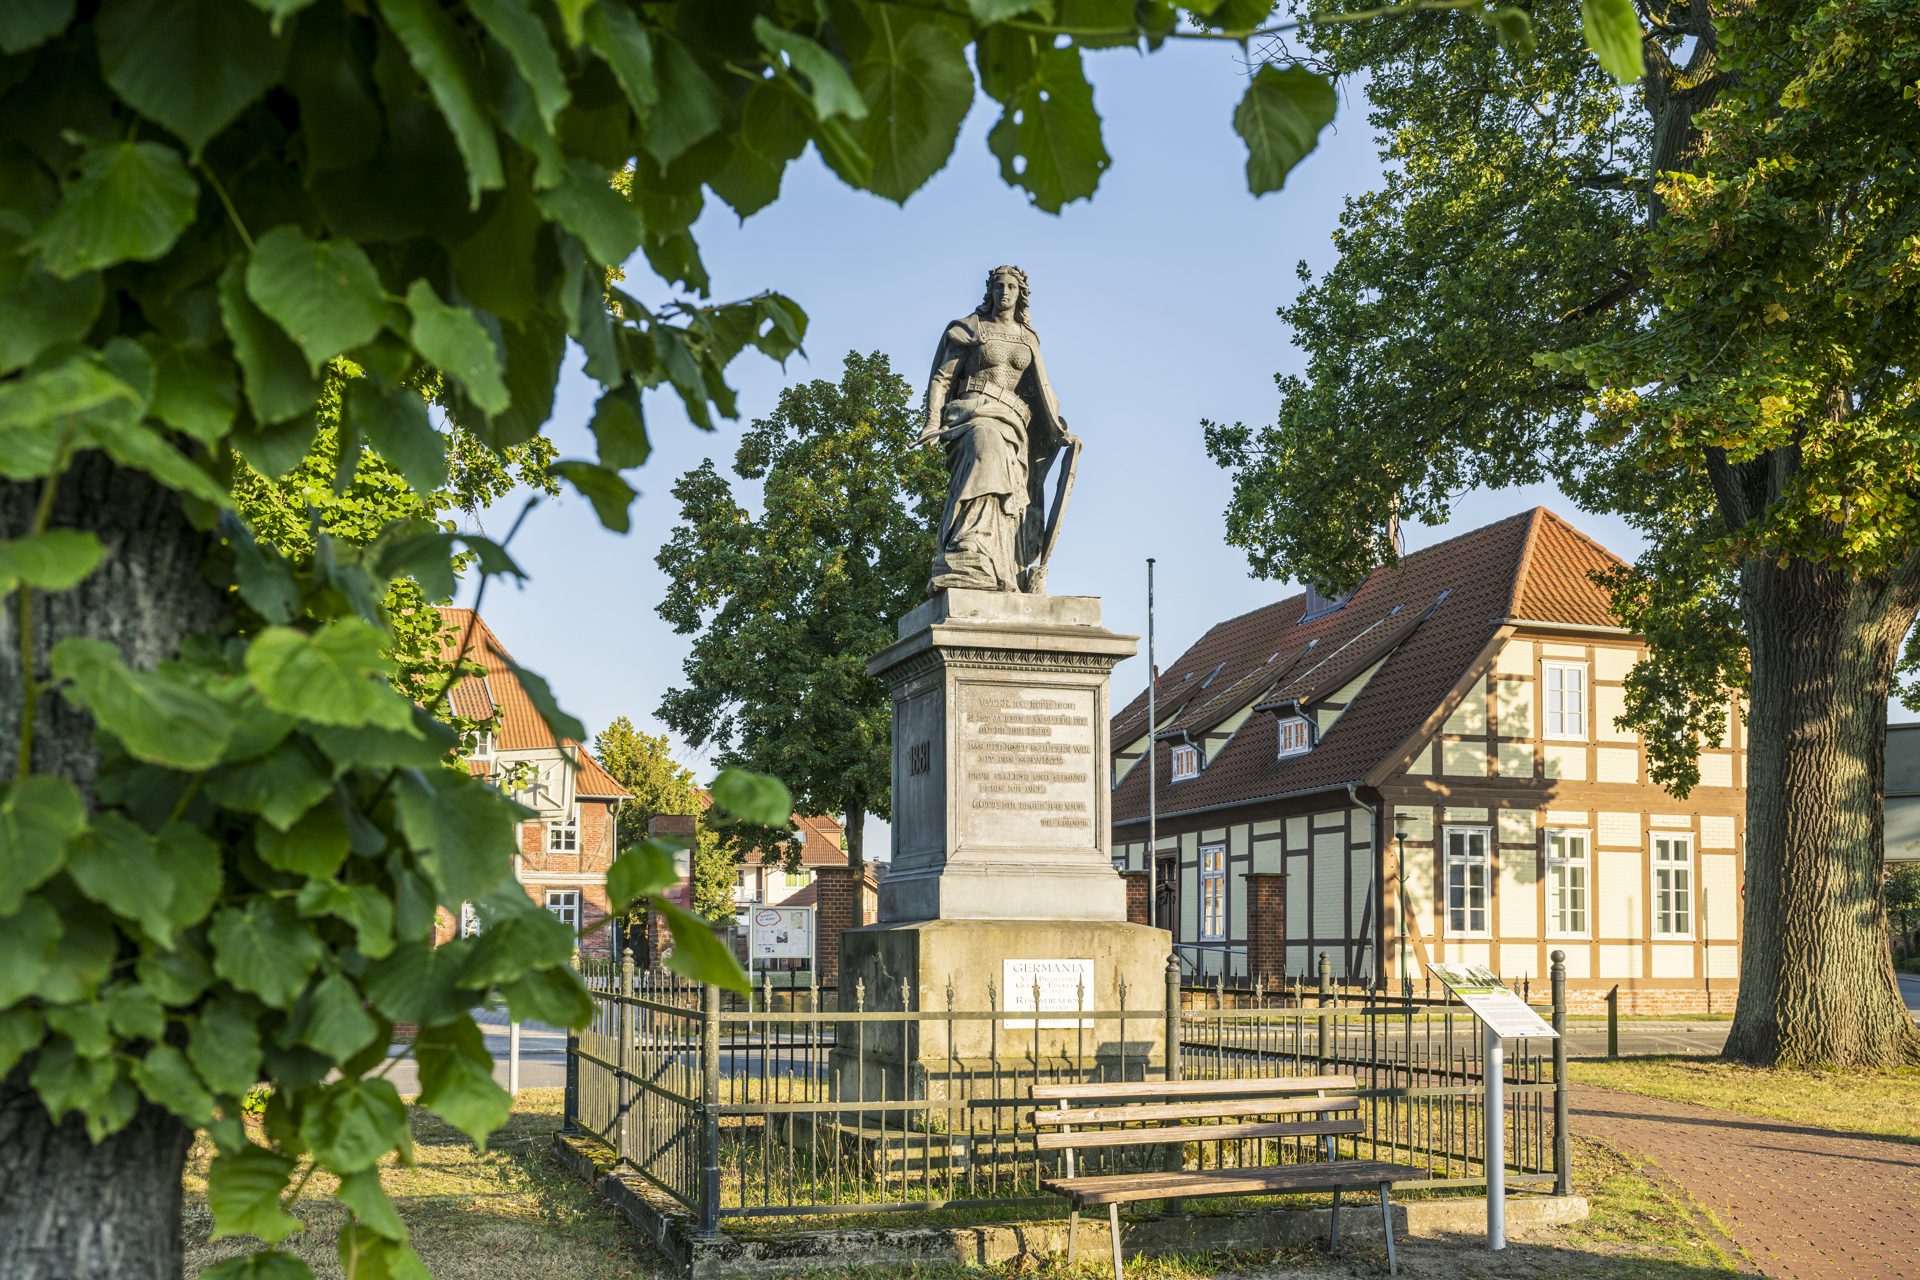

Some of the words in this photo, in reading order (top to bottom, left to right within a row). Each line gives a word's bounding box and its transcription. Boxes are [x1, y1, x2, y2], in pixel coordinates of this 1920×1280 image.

[909, 740, 931, 777] 1881
[1013, 963, 1084, 973] GERMANIA
[1016, 996, 1082, 1004] RESAURATIO
